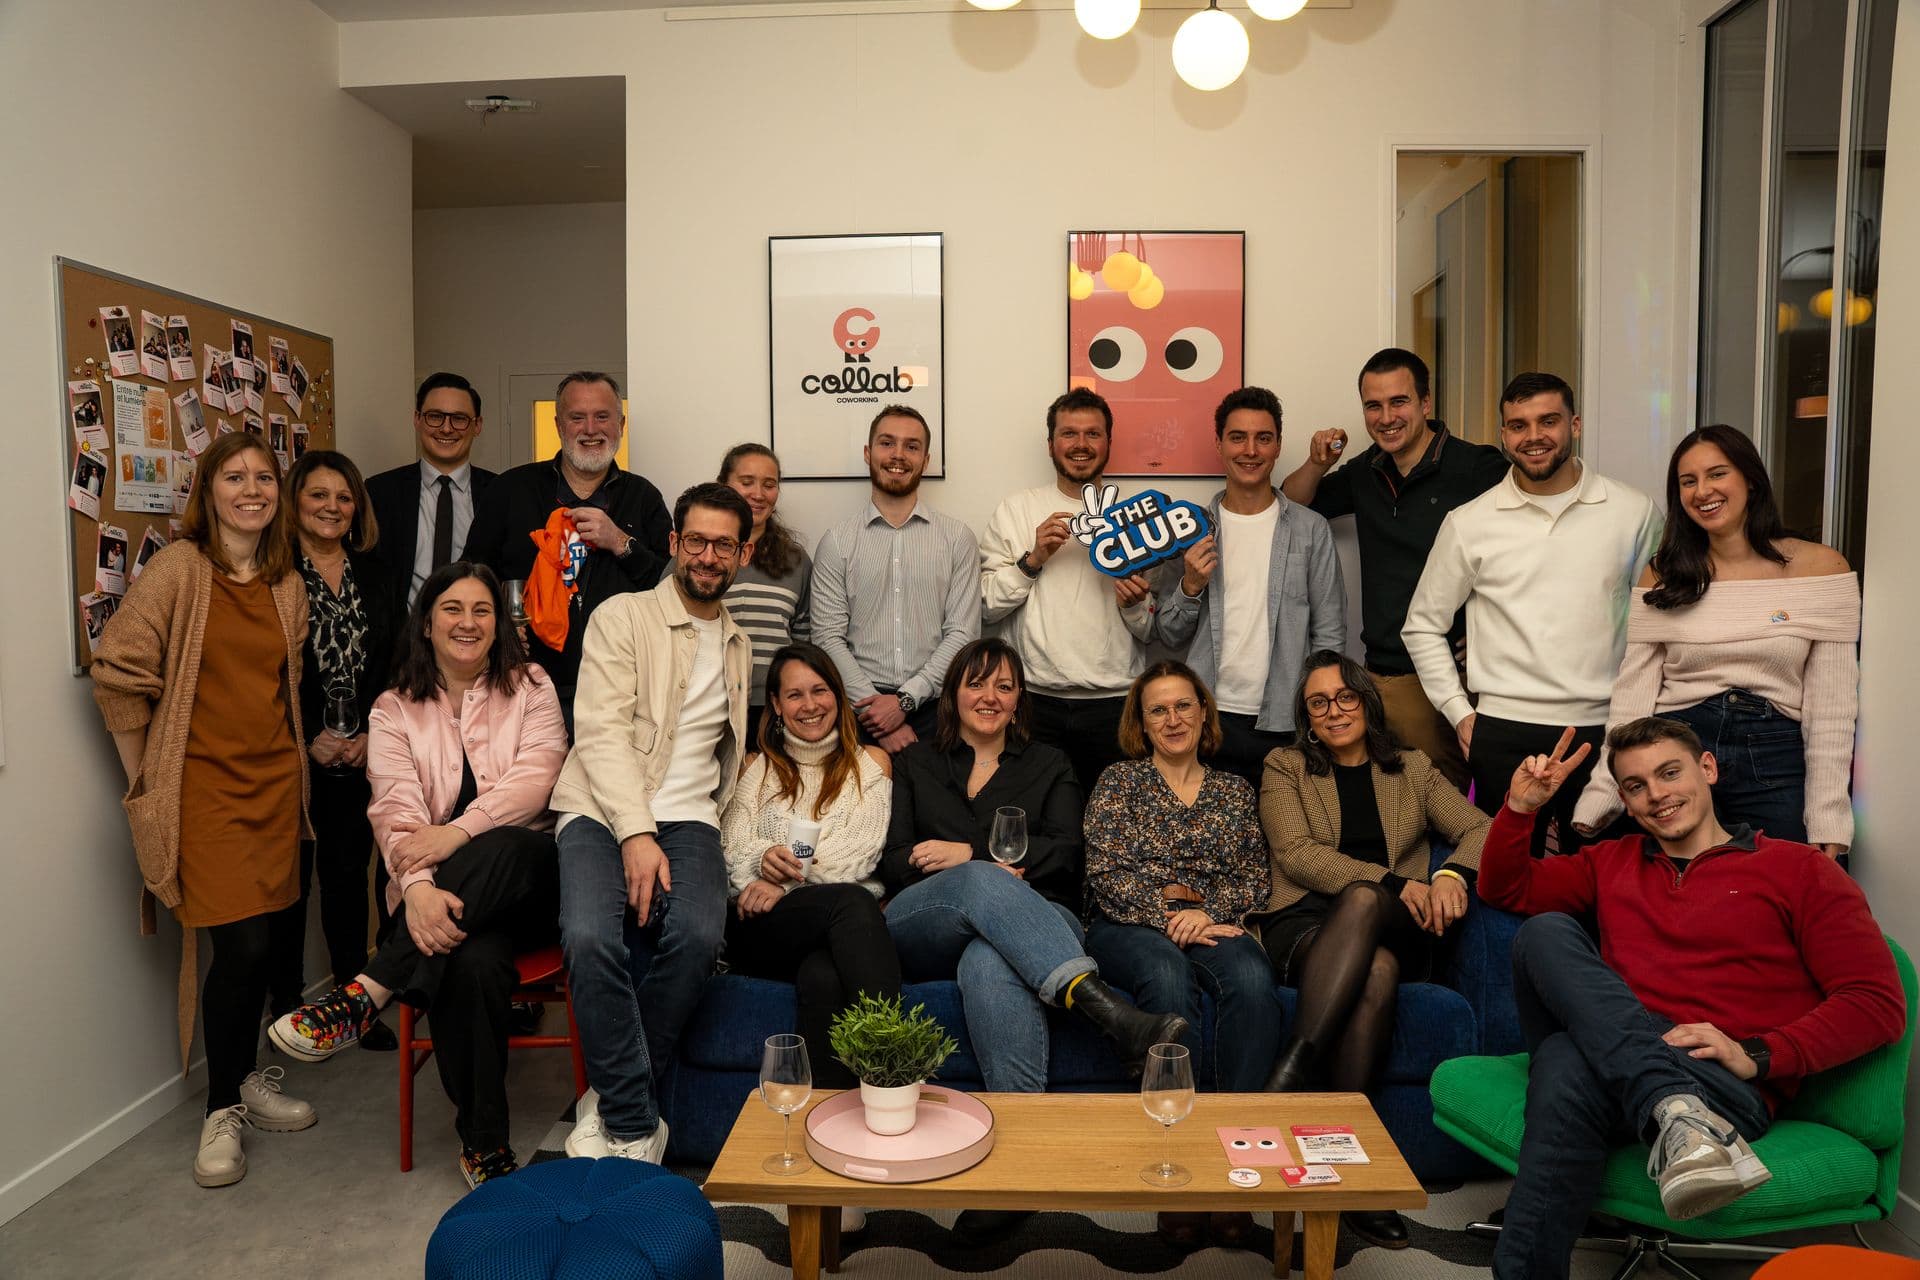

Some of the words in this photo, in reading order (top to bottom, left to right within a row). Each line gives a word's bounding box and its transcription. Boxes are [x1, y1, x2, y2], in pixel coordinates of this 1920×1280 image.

[801, 366, 913, 395] collab
[1110, 496, 1158, 527] THE
[1095, 506, 1197, 569] CLUB
